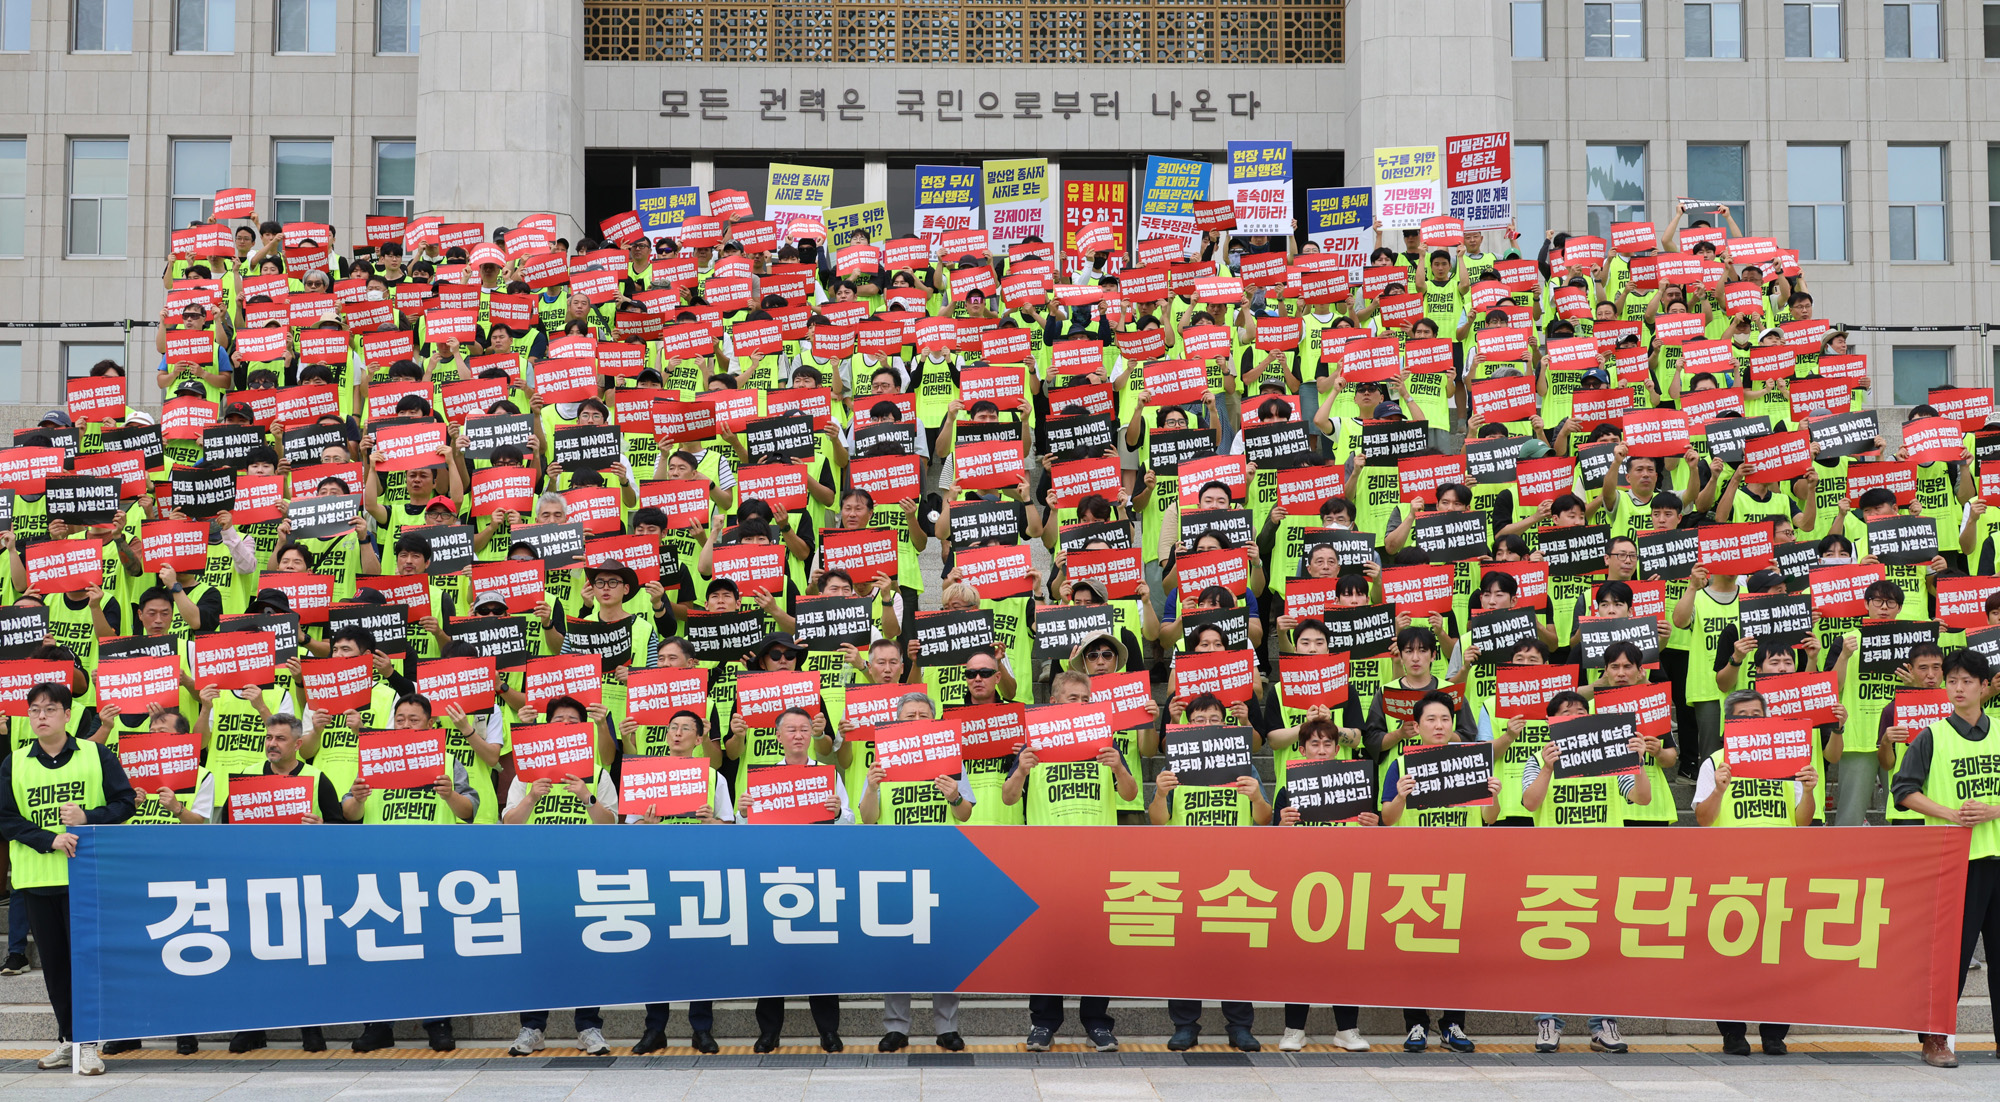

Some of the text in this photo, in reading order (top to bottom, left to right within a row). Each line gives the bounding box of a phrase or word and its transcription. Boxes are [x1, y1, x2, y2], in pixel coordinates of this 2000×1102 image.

[660, 88, 1261, 122] 모든 권력은 국민으로부터 나온다
[1449, 133, 1507, 154] 마필관리사
[1233, 148, 1286, 163] 현장 무시
[1378, 152, 1436, 167] 누구를 위한
[1461, 150, 1496, 168] 생존권
[988, 166, 1044, 184] 말산업 종사자
[1157, 163, 1202, 174] 경마산업
[1234, 163, 1286, 179] 밀실행정,
[1382, 165, 1432, 180] 이전인가?
[1456, 166, 1501, 184] 박탈하는
[772, 174, 830, 187] 말산업 종사자
[921, 174, 974, 188] 현장 무시
[775, 188, 823, 201] 사지로 모는
[921, 190, 973, 204] 밀실행정,
[992, 182, 1040, 198] 사지로 모는
[1067, 183, 1124, 202] 유혈사태
[1148, 189, 1204, 200] 마필관리사
[1237, 189, 1284, 203] 졸속이전
[1384, 188, 1432, 201] 기만행위
[1451, 187, 1508, 206] 경마장 이전 계획
[640, 192, 696, 211] 국민의 휴식처
[1144, 201, 1178, 213] 생존권
[1311, 194, 1368, 212] 국민의 휴식처
[1382, 202, 1434, 216] 중단하라!
[828, 213, 858, 231] 누구를
[863, 207, 884, 223] 위한
[994, 208, 1041, 223] 강제이전
[1235, 206, 1287, 219] 폐기하라!
[1320, 211, 1360, 227] 경마장,
[1468, 204, 1510, 221] 무효화하라!!
[923, 215, 970, 229] 졸속이전
[834, 223, 882, 246] 이전가?
[992, 225, 1044, 240] 결사반대!
[1066, 232, 1122, 250] 목고
[1323, 237, 1359, 252] 우리가
[1427, 292, 1453, 303] 경마공원
[1344, 346, 1393, 362] 말종사자 외면한
[1344, 356, 1398, 372] 졸속이전 멈춰라!
[536, 366, 592, 382] 말종사자 외면한
[571, 377, 596, 387] 멈춰라!
[923, 372, 951, 384] 경마공원
[962, 375, 1018, 389] 말종사자 외면한
[923, 384, 952, 396] 이전반대
[963, 386, 1022, 400] 졸속이전 멈춰라!
[1410, 384, 1441, 397] 이전반대
[47, 486, 117, 499] 무대포 마사이전,
[49, 500, 119, 512] 경주마 사형선고!
[1700, 532, 1767, 550] 말종사자 외면한
[1869, 525, 1934, 543] 무대포 마사이전,
[1702, 543, 1772, 563] 졸속이전 멈춰라!
[1902, 538, 1937, 550] 사형선고!
[28, 548, 95, 570] 말종사자 외면한
[30, 560, 100, 582] 졸속이전 멈춰라!
[917, 619, 990, 642] 무대포 마사이전,
[952, 633, 992, 649] 사형선고!
[99, 666, 172, 686] 말종사자 외면한
[100, 679, 177, 700] 졸속이전 멈춰라!
[218, 714, 266, 732] 경마공원
[1028, 712, 1105, 735] 말종사자 외면한
[216, 734, 266, 752] 이전반대
[878, 730, 954, 754] 말종사자 외면한
[1076, 726, 1112, 742] 멈춰라!
[1727, 730, 1805, 748] 말종사자 외면한
[361, 740, 438, 761] 말종사자 외면한
[925, 744, 960, 760] 멈춰라!
[1168, 737, 1249, 756] 무대포 마사이전,
[1728, 745, 1809, 764] 졸속이전 멈춰라!
[362, 753, 444, 775] 졸속이전 멈춰라!
[1205, 753, 1250, 768] 사형선고!
[1046, 763, 1099, 782] 경마공원
[1288, 771, 1369, 792] 무대포 마사이전,
[27, 781, 85, 807] 경마공원
[231, 787, 305, 806] 말종사자 외면한
[1049, 783, 1100, 803] 이전반대
[1325, 786, 1370, 803] 사형선고!
[1552, 783, 1606, 804] 경마공원
[1730, 780, 1784, 798] 경마공원
[1184, 789, 1237, 810] 경마공원
[31, 804, 86, 828] 이전
[232, 806, 274, 820] 졸속이전
[383, 802, 436, 821] 이전반대
[895, 805, 947, 824] 이전반대
[1186, 810, 1238, 826] 이전반대
[1556, 805, 1607, 825] 이전반대
[1734, 800, 1786, 820] 이전반대
[146, 867, 938, 975] 경마산업 붕괴한다
[1104, 870, 1890, 968] 졸속이전 중단하라
